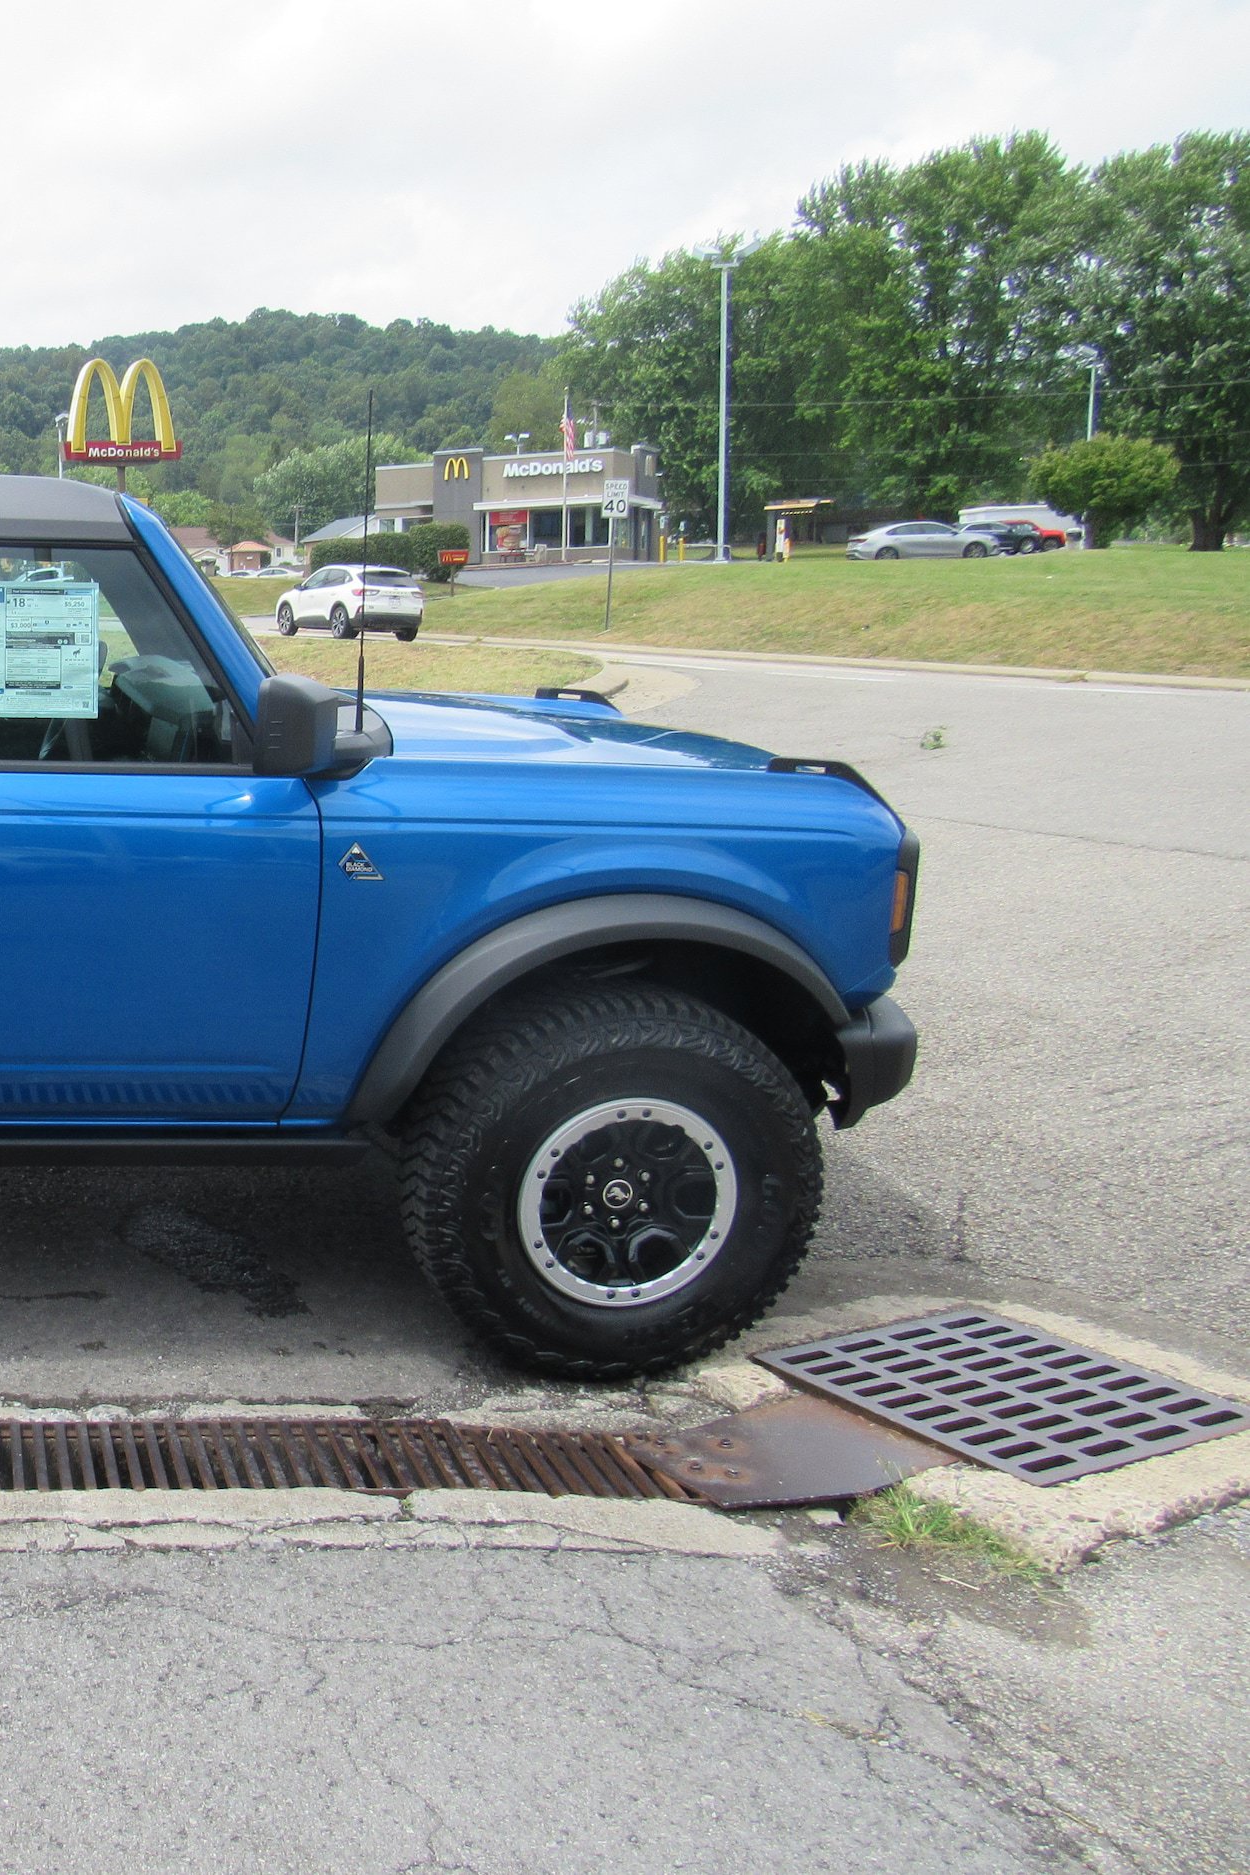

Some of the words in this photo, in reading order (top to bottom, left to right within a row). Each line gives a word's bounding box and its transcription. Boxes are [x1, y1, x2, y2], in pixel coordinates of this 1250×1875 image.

[88, 447, 160, 458] McDonald's
[503, 459, 603, 478] McDonald's
[604, 499, 627, 514] 40
[13, 598, 26, 607] 18
